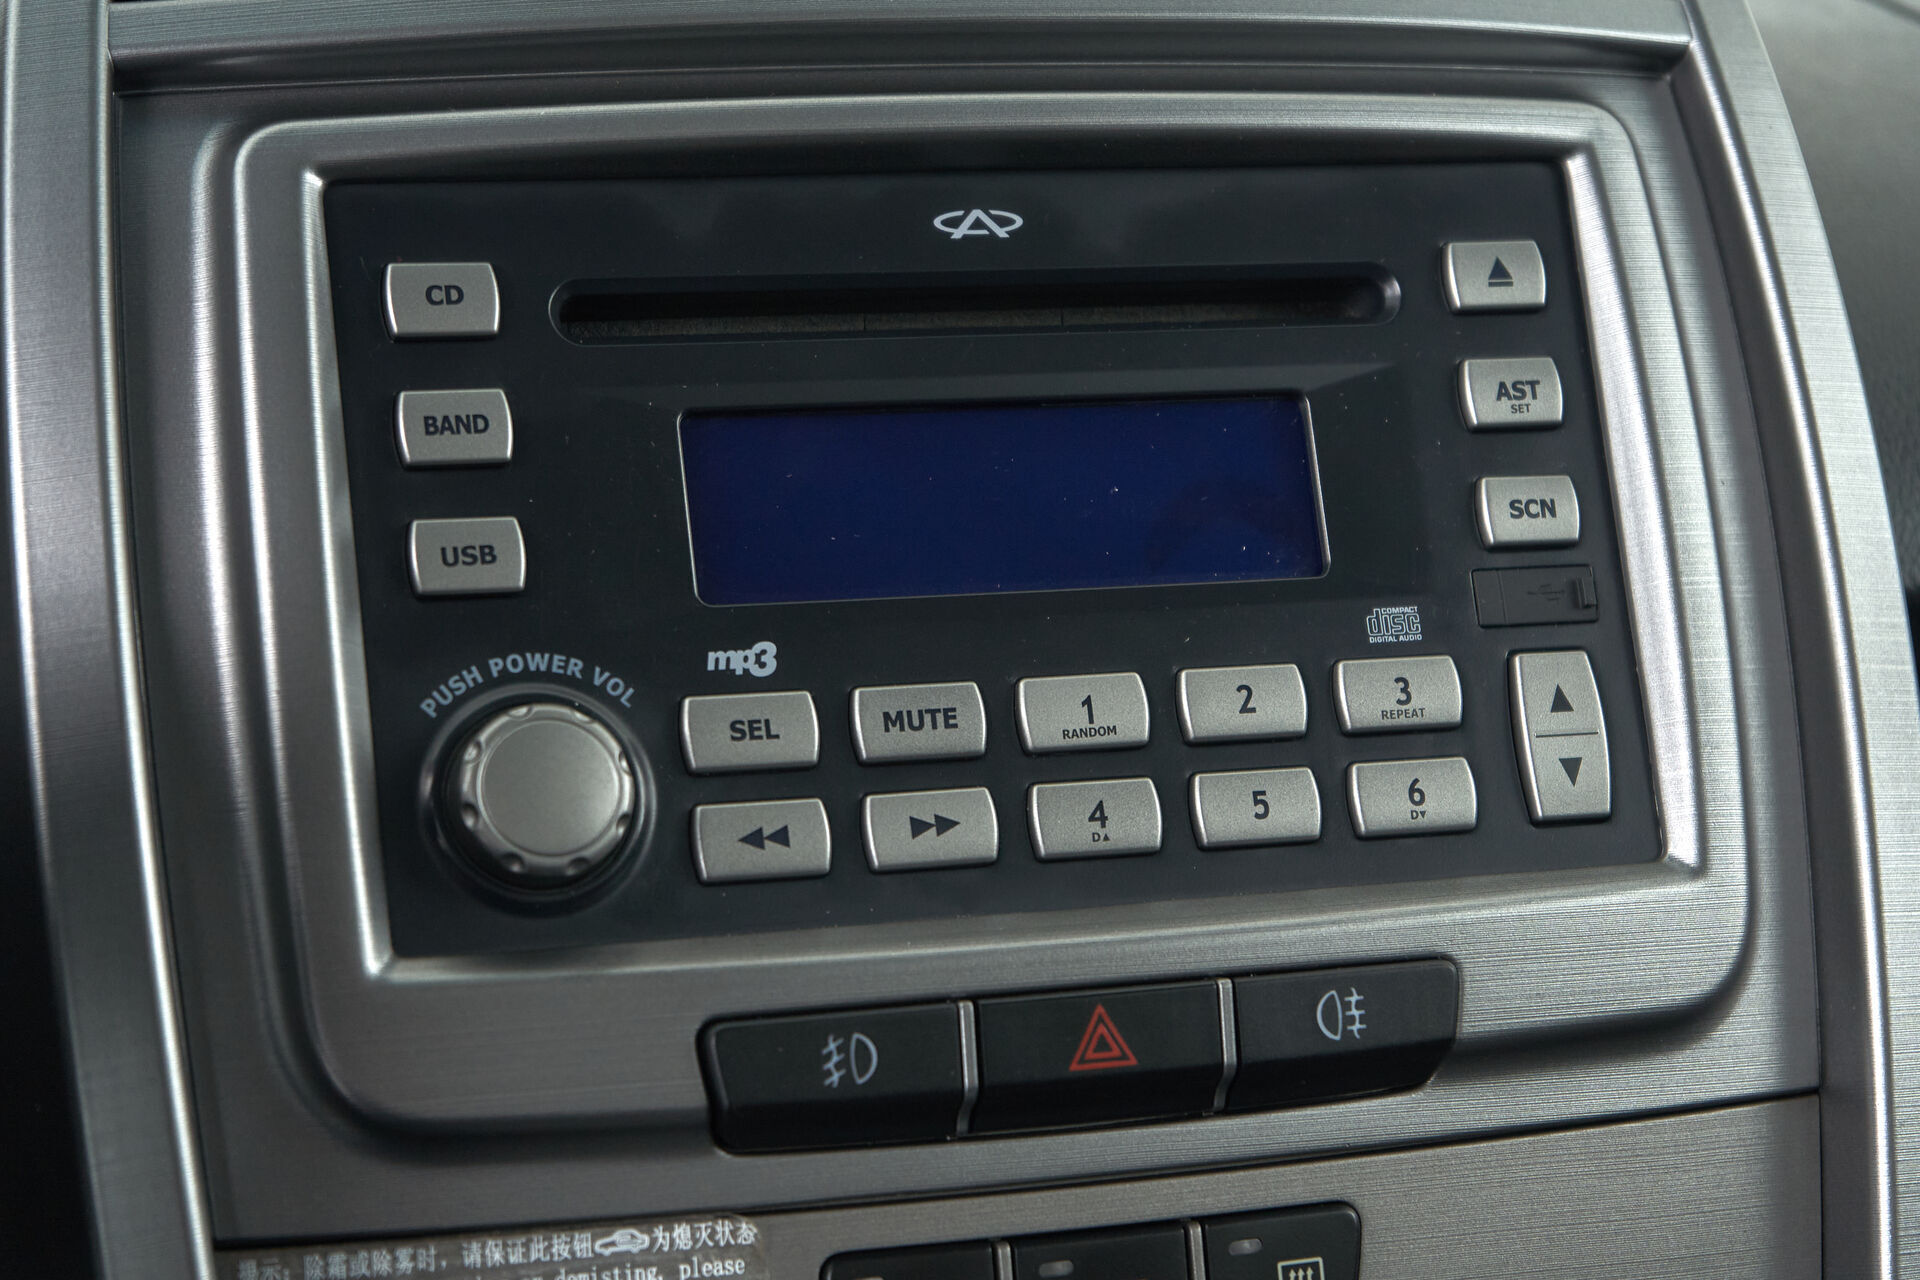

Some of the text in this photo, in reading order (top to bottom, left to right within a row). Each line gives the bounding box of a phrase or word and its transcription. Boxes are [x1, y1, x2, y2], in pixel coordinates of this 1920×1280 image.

[425, 285, 464, 306] CD
[1497, 380, 1540, 401] AST
[1511, 403, 1530, 414] SET
[423, 414, 489, 436] BAND
[1509, 498, 1557, 519] SCN
[440, 545, 497, 567] USB
[1381, 606, 1418, 614] COMPACT
[1366, 608, 1421, 636] disc
[1369, 633, 1422, 643] DIGITAL AUDIO
[707, 641, 777, 677] mp3
[420, 652, 636, 719] PUSH POWER VOL
[1394, 677, 1412, 706] 3
[1081, 694, 1094, 724] 1
[1236, 684, 1256, 714] 2
[883, 707, 958, 733] MUTE
[1381, 708, 1425, 720] REPEAT
[729, 718, 780, 742] SEL
[1062, 726, 1117, 740] RANDOM
[1408, 778, 1425, 806] 6
[1088, 800, 1108, 828] 4
[1252, 790, 1270, 819] 5
[679, 1257, 745, 1280] please
